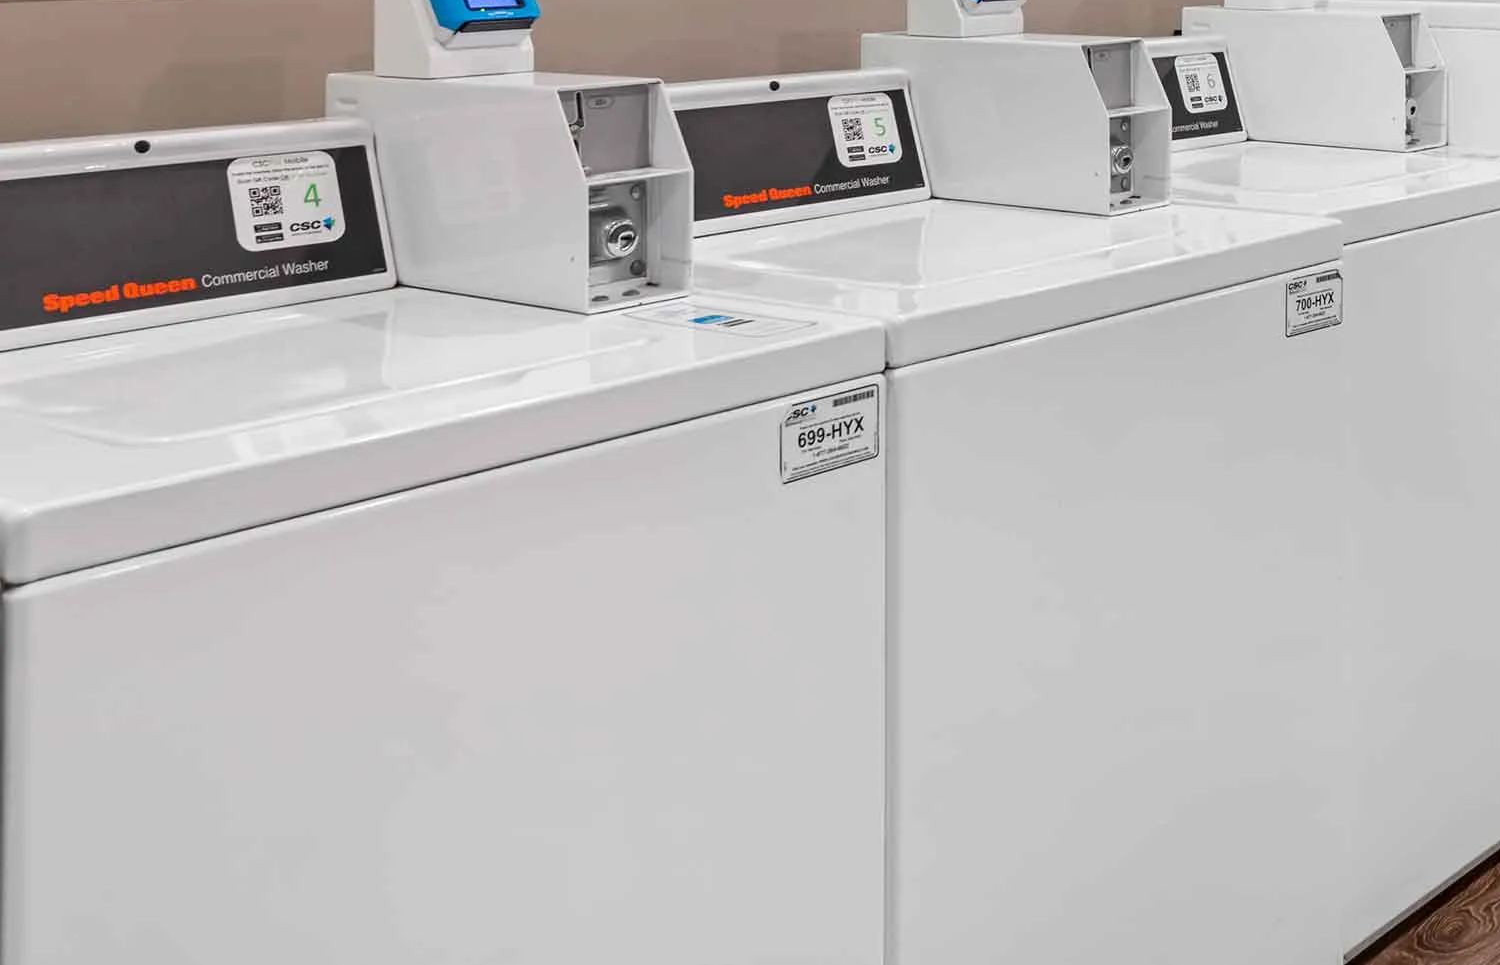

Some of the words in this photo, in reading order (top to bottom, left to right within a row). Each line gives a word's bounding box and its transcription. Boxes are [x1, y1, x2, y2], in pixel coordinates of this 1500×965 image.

[1207, 73, 1216, 89] 6
[874, 117, 886, 136] 5
[868, 145, 887, 154] CSC
[303, 182, 322, 207] 4
[723, 189, 767, 209] Speed
[769, 184, 813, 201] Queen
[813, 178, 860, 195] Commercial
[860, 175, 890, 188] Washer
[289, 220, 321, 232] CSC
[42, 286, 121, 314] Speed
[123, 277, 197, 299] Queen
[201, 265, 280, 289] Commercial
[282, 258, 330, 278] Washer
[1295, 291, 1335, 312] 700-HYX
[797, 415, 865, 448] 699-HYX
